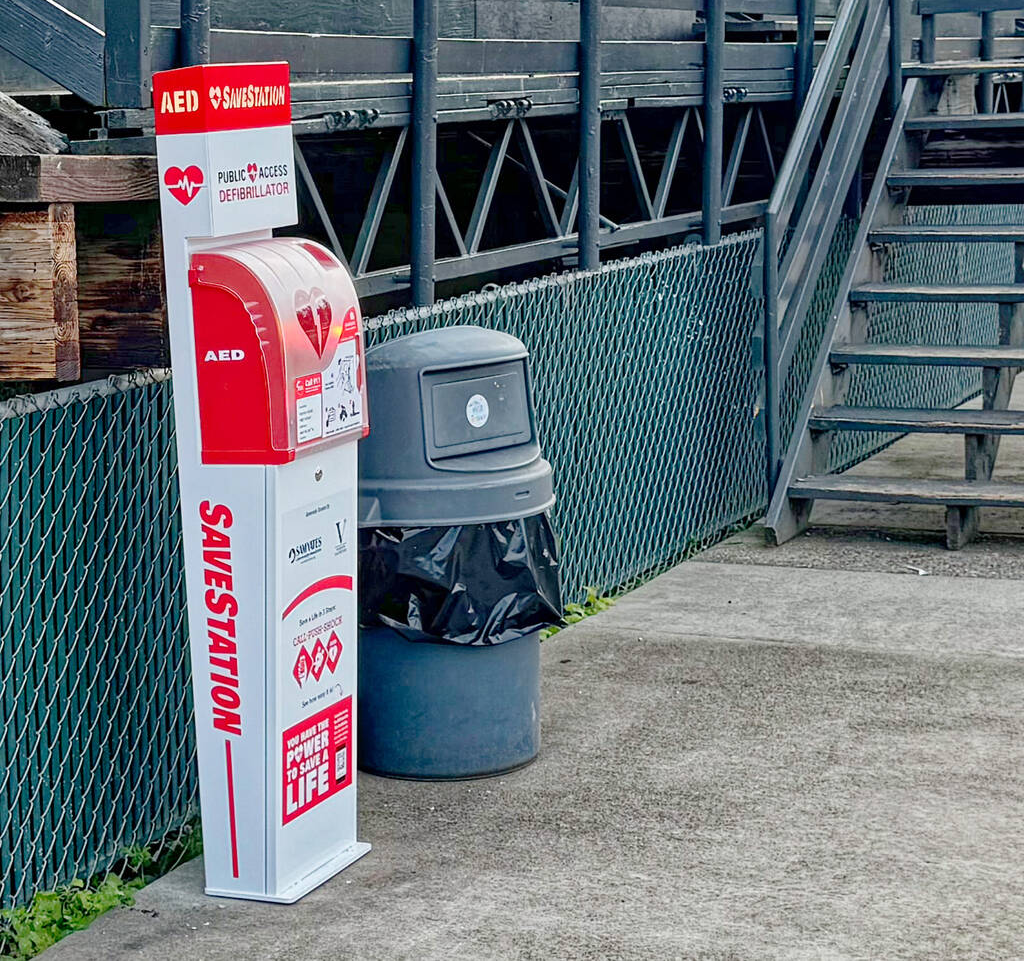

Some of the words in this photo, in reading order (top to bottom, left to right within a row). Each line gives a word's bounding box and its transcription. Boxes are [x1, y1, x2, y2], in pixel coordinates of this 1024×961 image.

[161, 89, 199, 114] AED
[222, 84, 285, 110] SAVESTATION
[218, 168, 246, 184] PUBLIC
[258, 164, 288, 179] ACCESS
[218, 182, 289, 203] DEFIBRILLATOR
[204, 349, 245, 363] AED
[199, 500, 241, 736] SAVESTATION
[287, 767, 298, 783] TO
[299, 753, 320, 775] SAVE
[322, 748, 329, 763] A
[286, 761, 329, 816] LIFE
